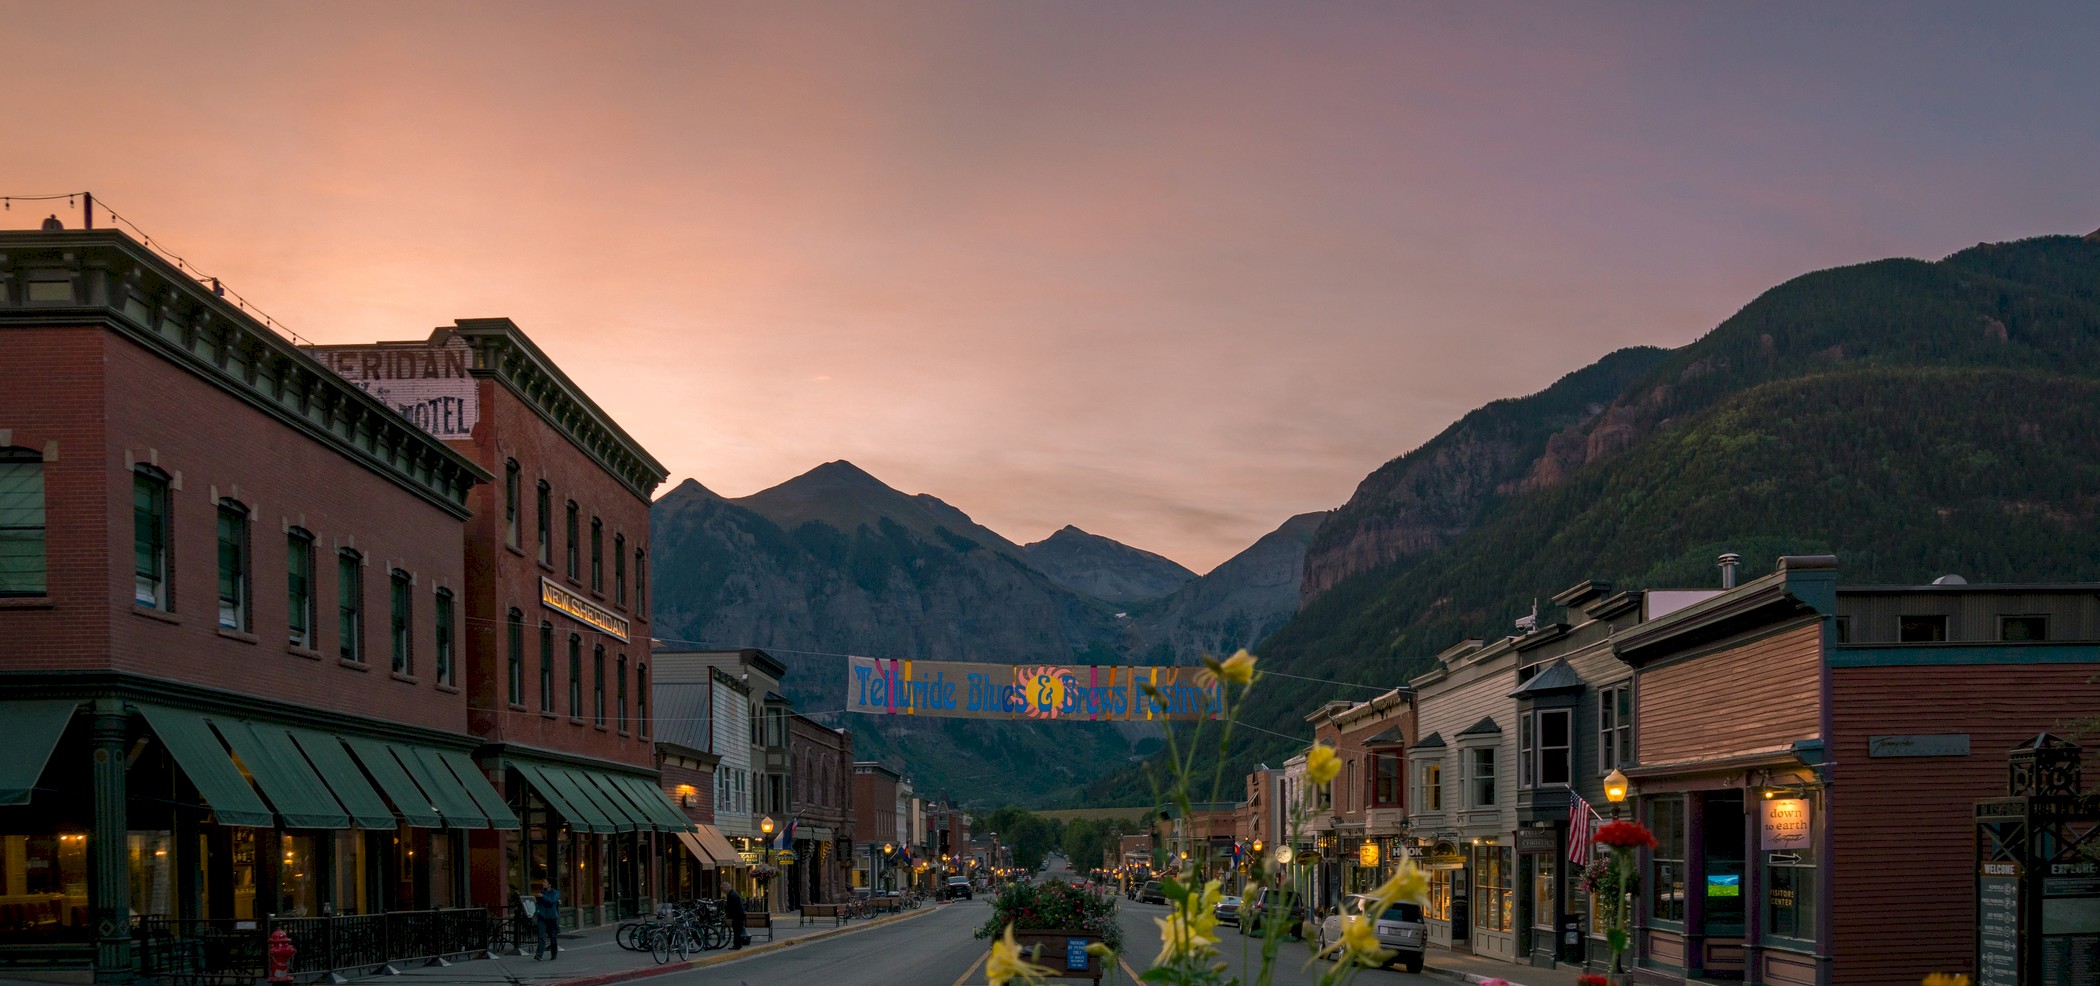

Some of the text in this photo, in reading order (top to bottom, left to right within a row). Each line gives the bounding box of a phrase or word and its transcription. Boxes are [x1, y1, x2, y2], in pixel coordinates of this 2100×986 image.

[327, 350, 466, 380] ERIDAN
[543, 584, 627, 639] NEW SHERIDAN
[855, 665, 957, 710] Telluride
[967, 673, 1027, 713] Blues
[1037, 675, 1054, 713] &
[1061, 675, 1128, 714] Brews
[1770, 808, 1802, 818] down
[1765, 820, 1808, 831] to earth
[1392, 846, 1423, 857] HOK
[1984, 864, 2015, 875] WELCOME
[1770, 889, 1794, 898] VISITORS
[1771, 898, 1793, 907] CENTER
